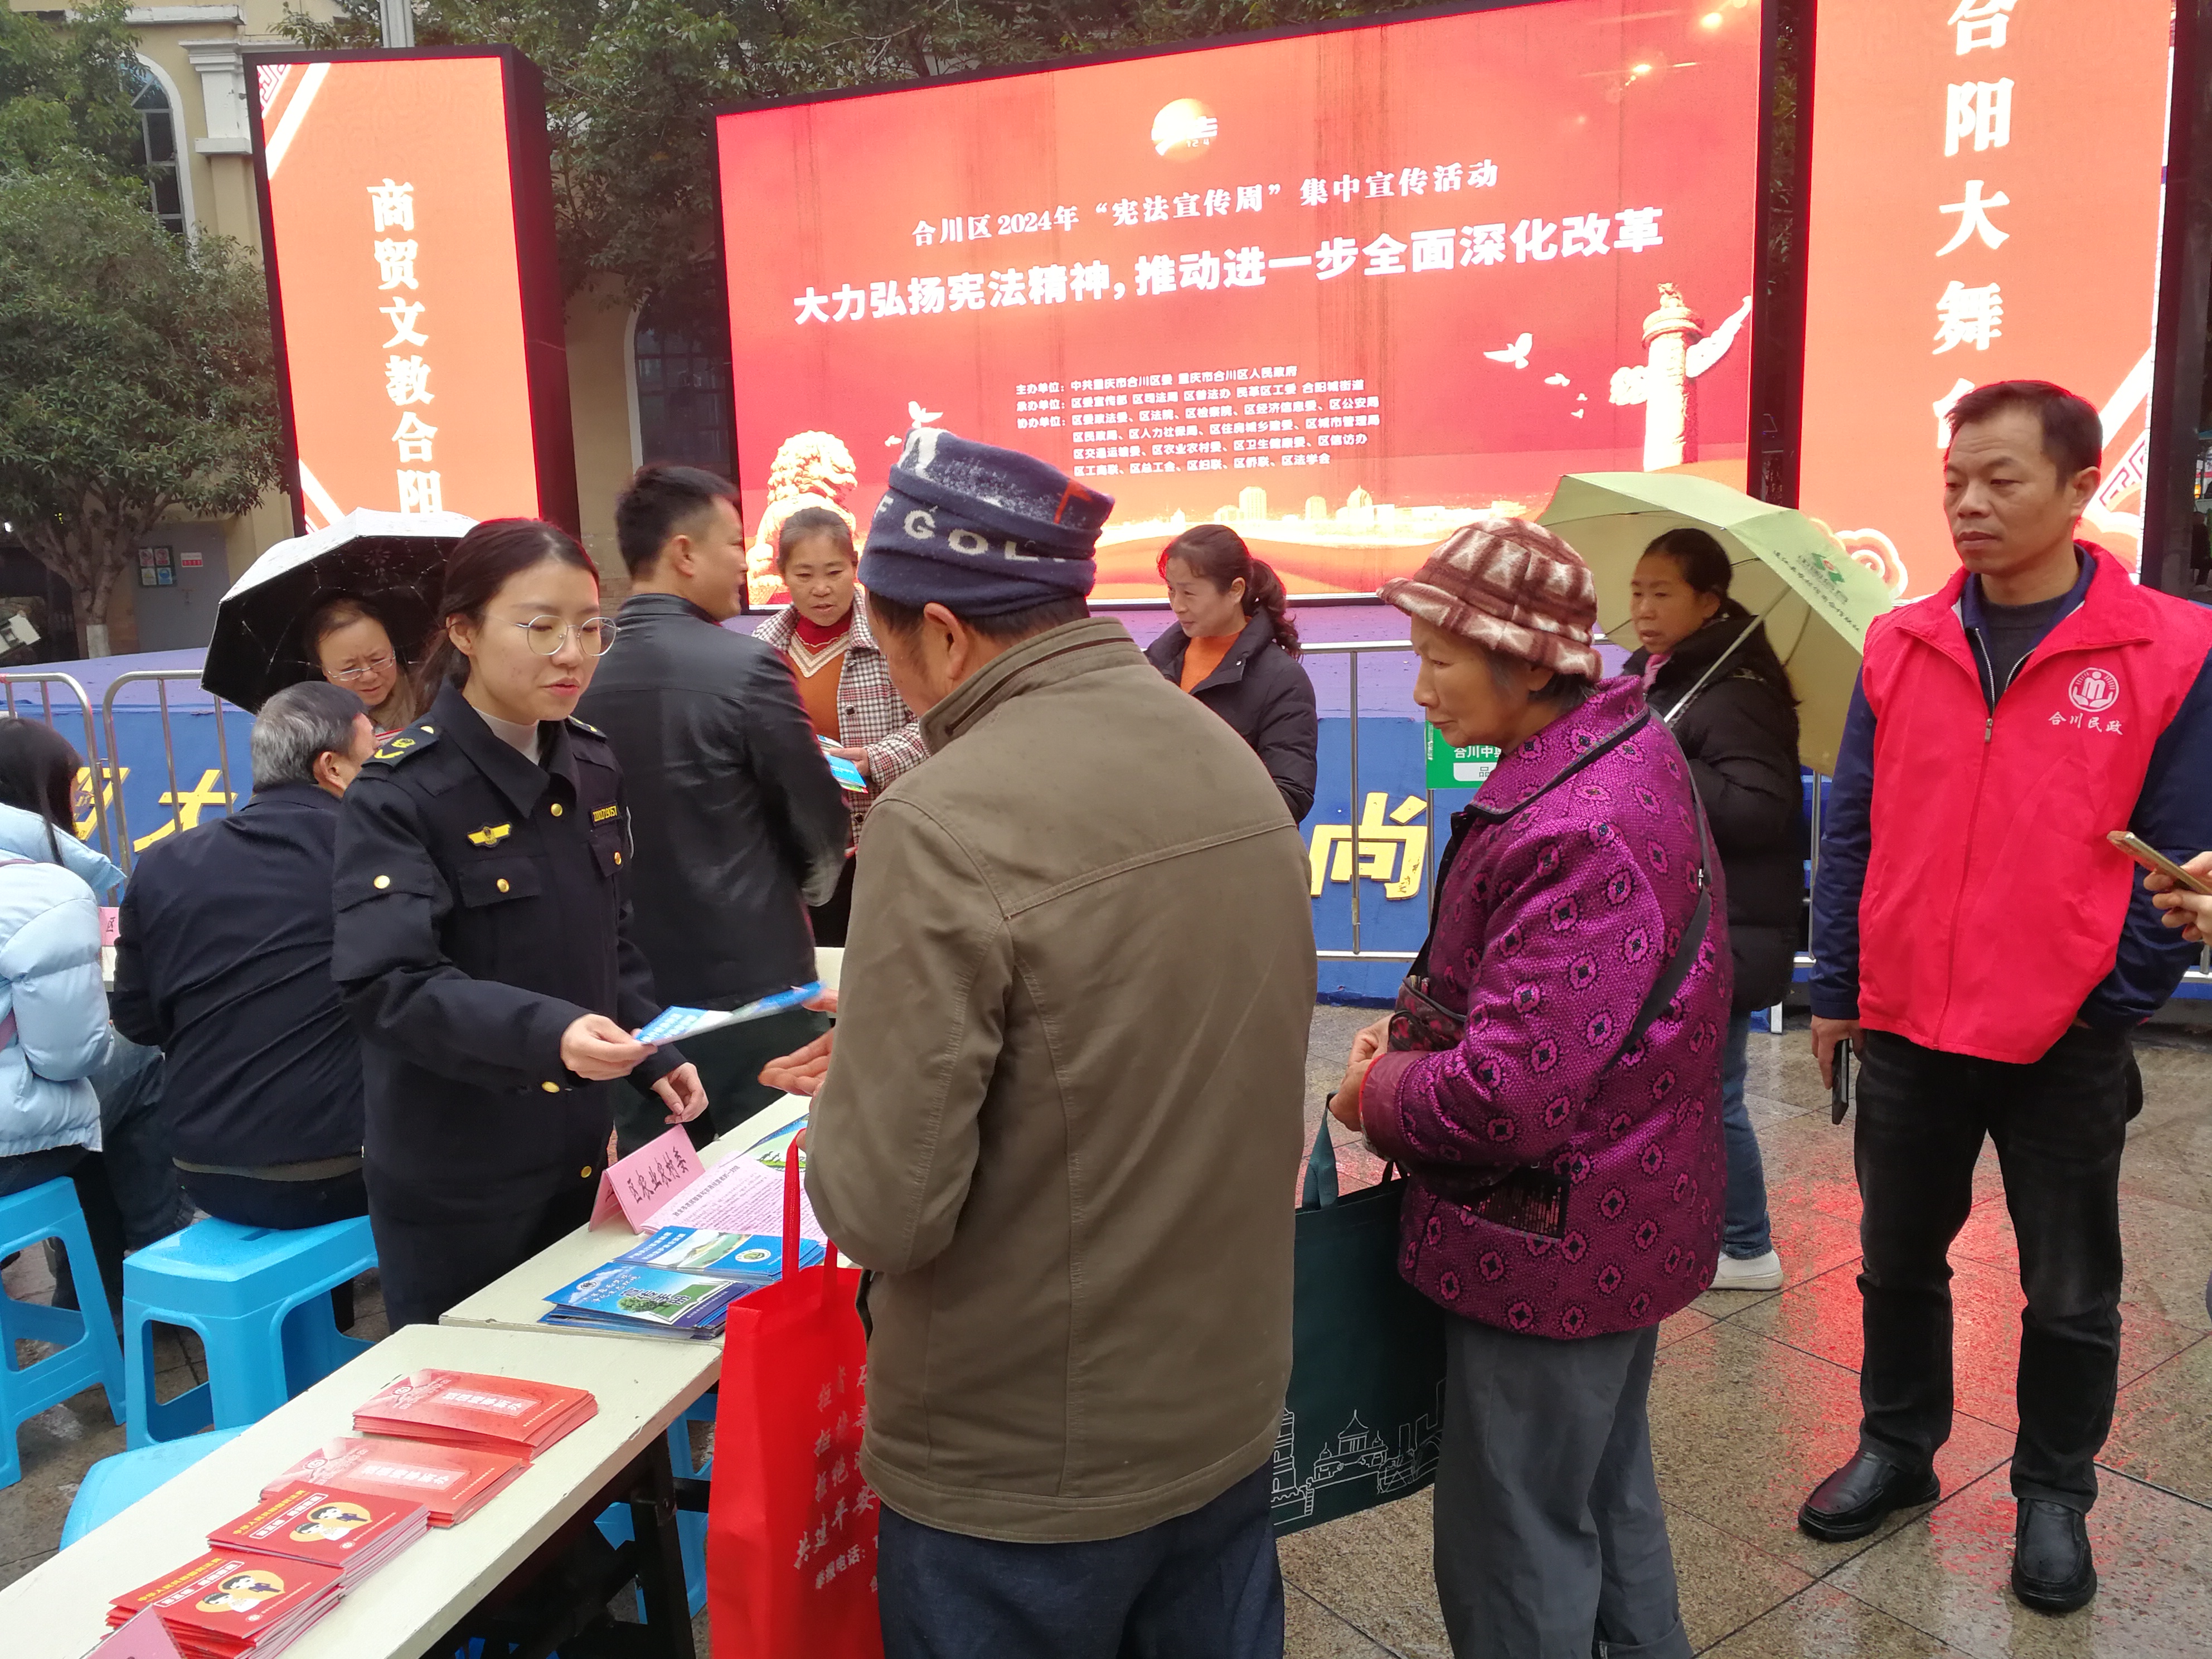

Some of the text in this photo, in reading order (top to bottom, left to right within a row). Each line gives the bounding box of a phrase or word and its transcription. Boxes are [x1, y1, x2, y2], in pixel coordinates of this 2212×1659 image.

[367, 178, 443, 513] 商贸文教合阳
[904, 508, 1066, 563] GOL
[2048, 711, 2123, 735] 合川民政
[232, 1489, 307, 1535] 中华人民共和国民法典
[137, 1557, 223, 1602] 中华人民共和国民法典
